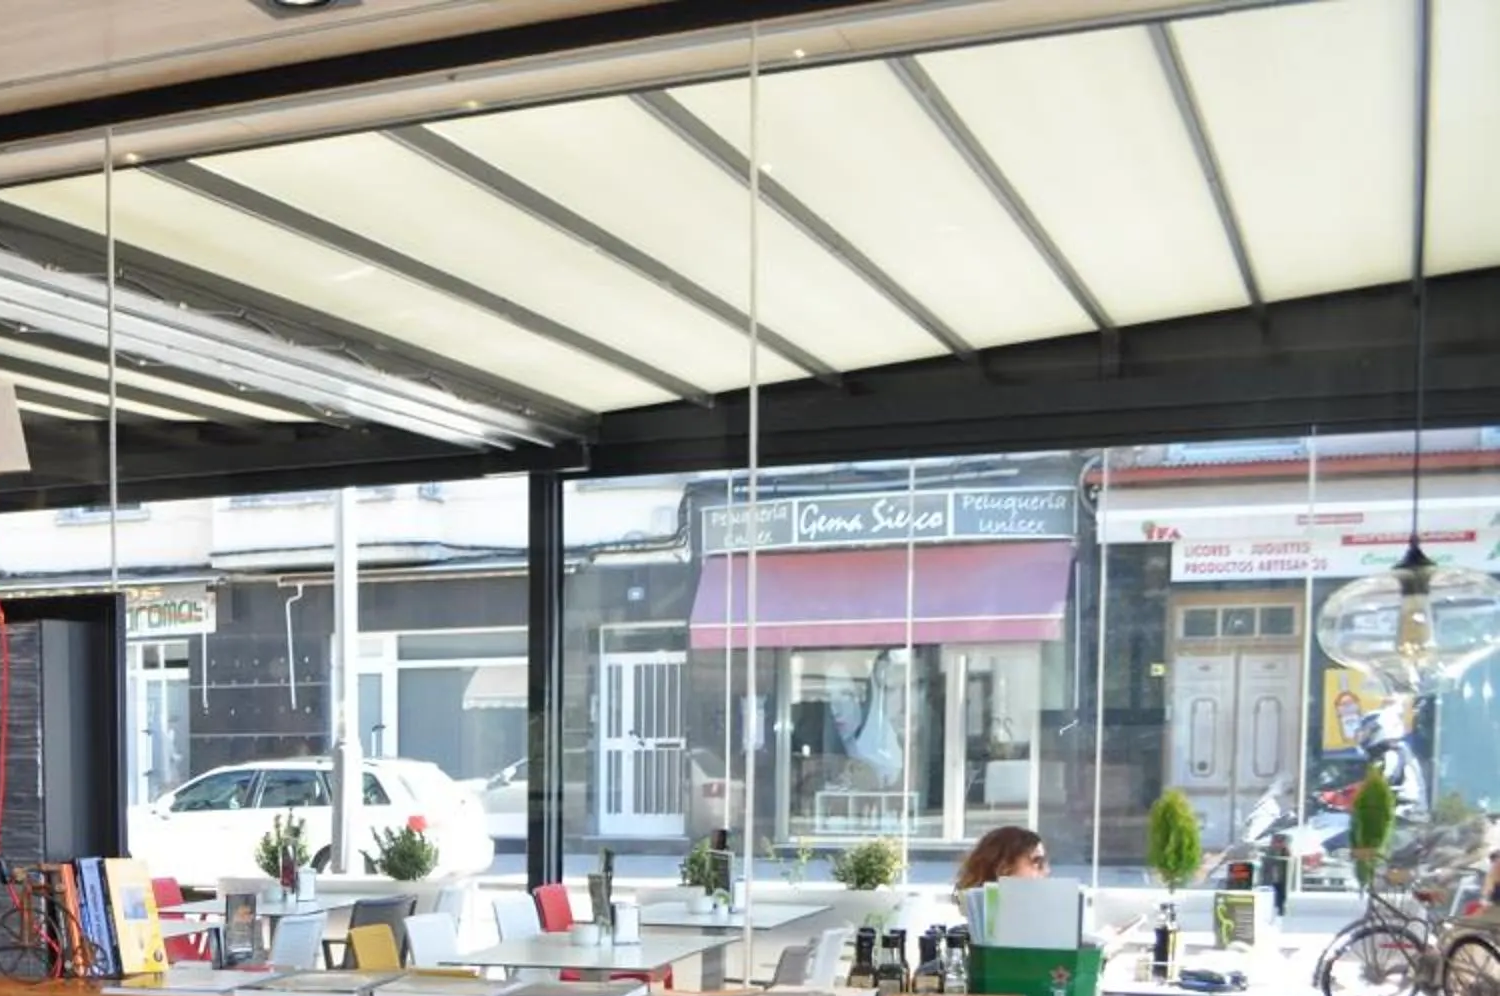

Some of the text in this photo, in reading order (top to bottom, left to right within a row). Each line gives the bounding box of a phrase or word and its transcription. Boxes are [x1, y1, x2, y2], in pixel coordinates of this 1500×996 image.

[800, 504, 862, 540] Gema
[1184, 543, 1231, 558] LICORES
[1184, 559, 1253, 574] PRODUCTOS
